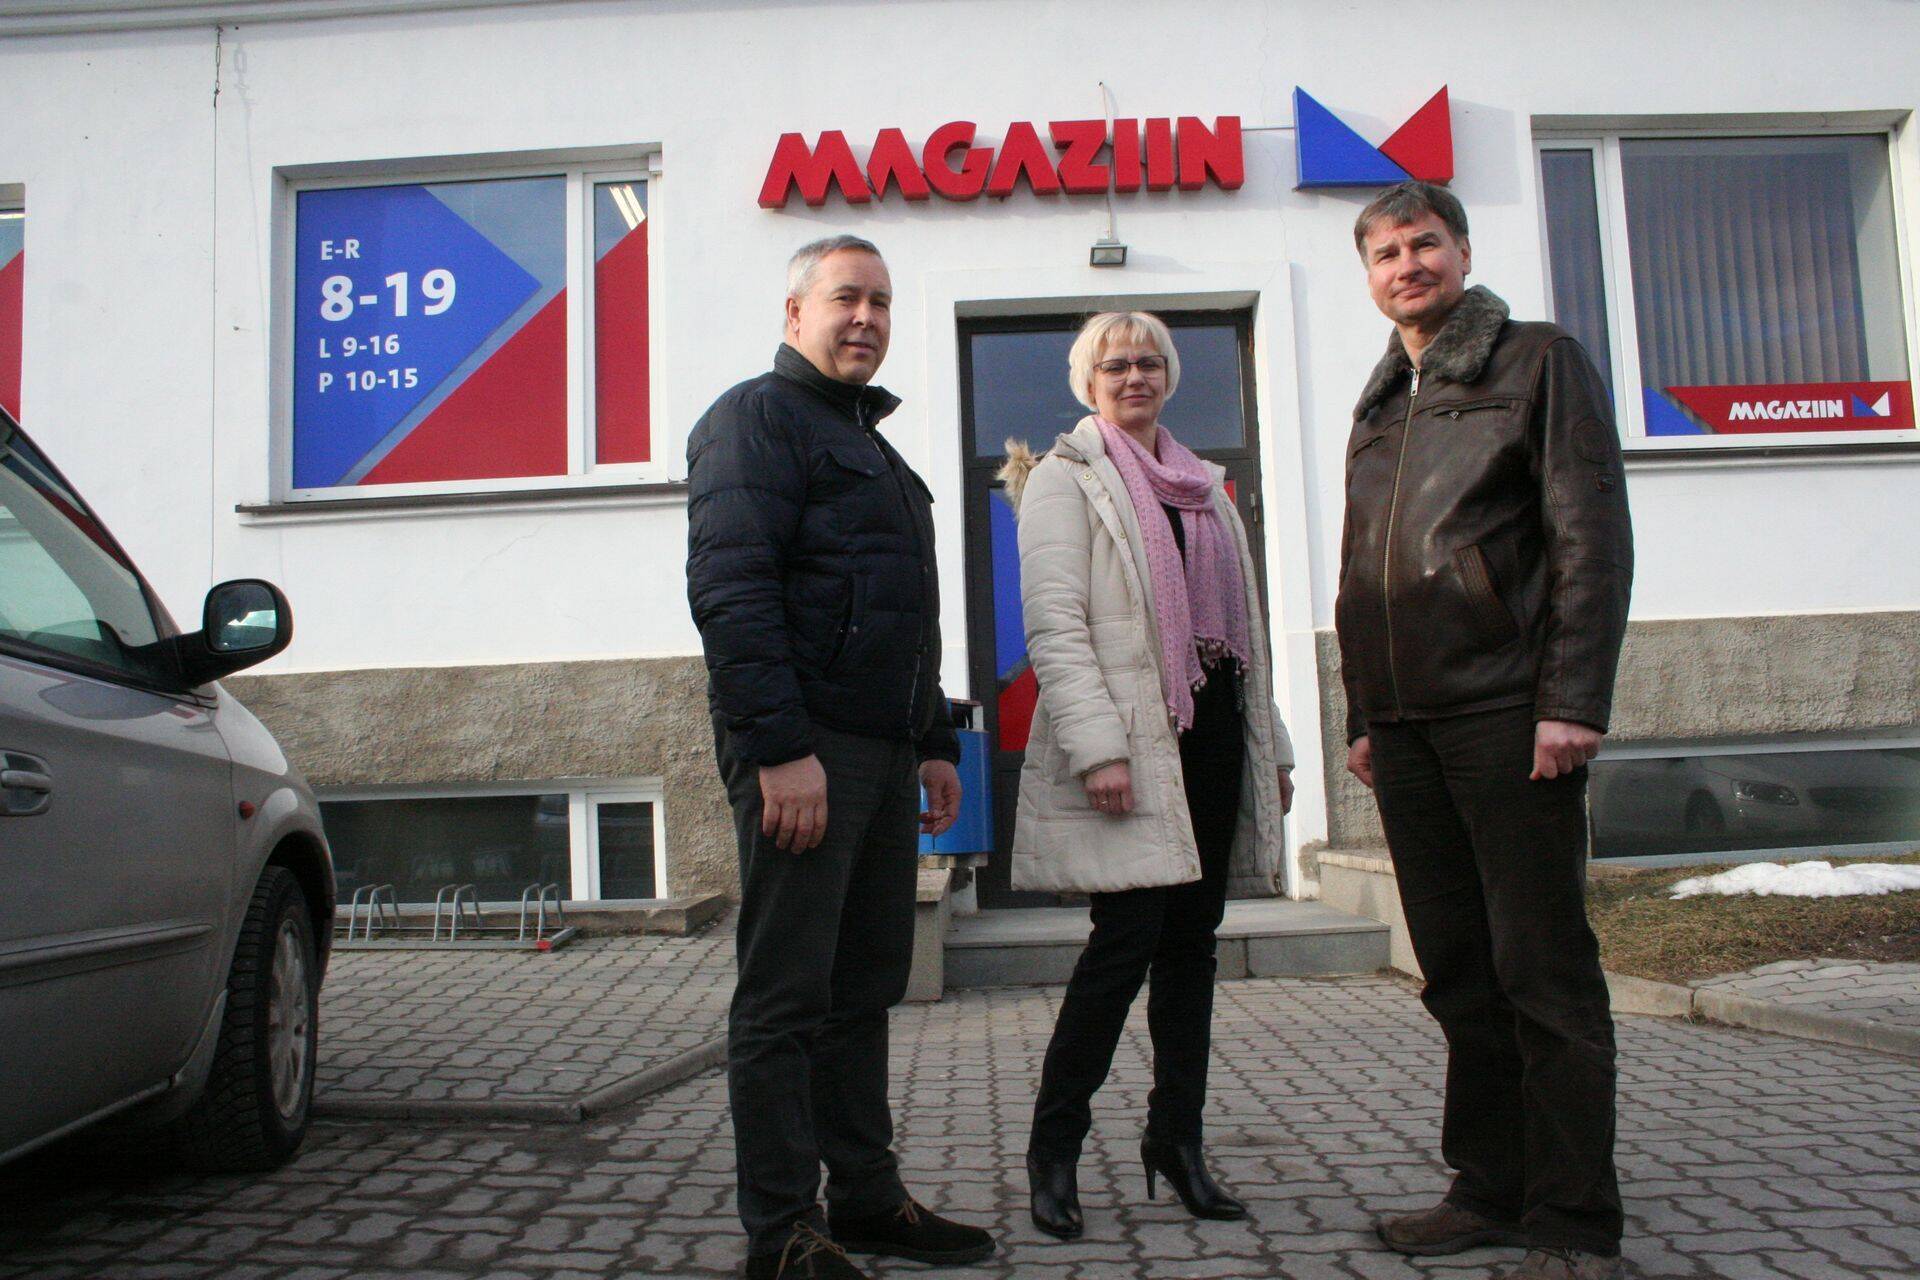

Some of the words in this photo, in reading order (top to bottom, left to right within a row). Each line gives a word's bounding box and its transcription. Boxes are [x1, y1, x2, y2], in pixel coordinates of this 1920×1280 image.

[758, 115, 1245, 208] MAGAZIIN
[320, 239, 360, 261] E-R
[320, 268, 456, 322] 8-19
[319, 338, 332, 359] L
[342, 334, 400, 358] 9-16
[319, 372, 333, 393] P
[346, 367, 418, 392] 10-15
[1728, 400, 1844, 421] MAGAZIIN
